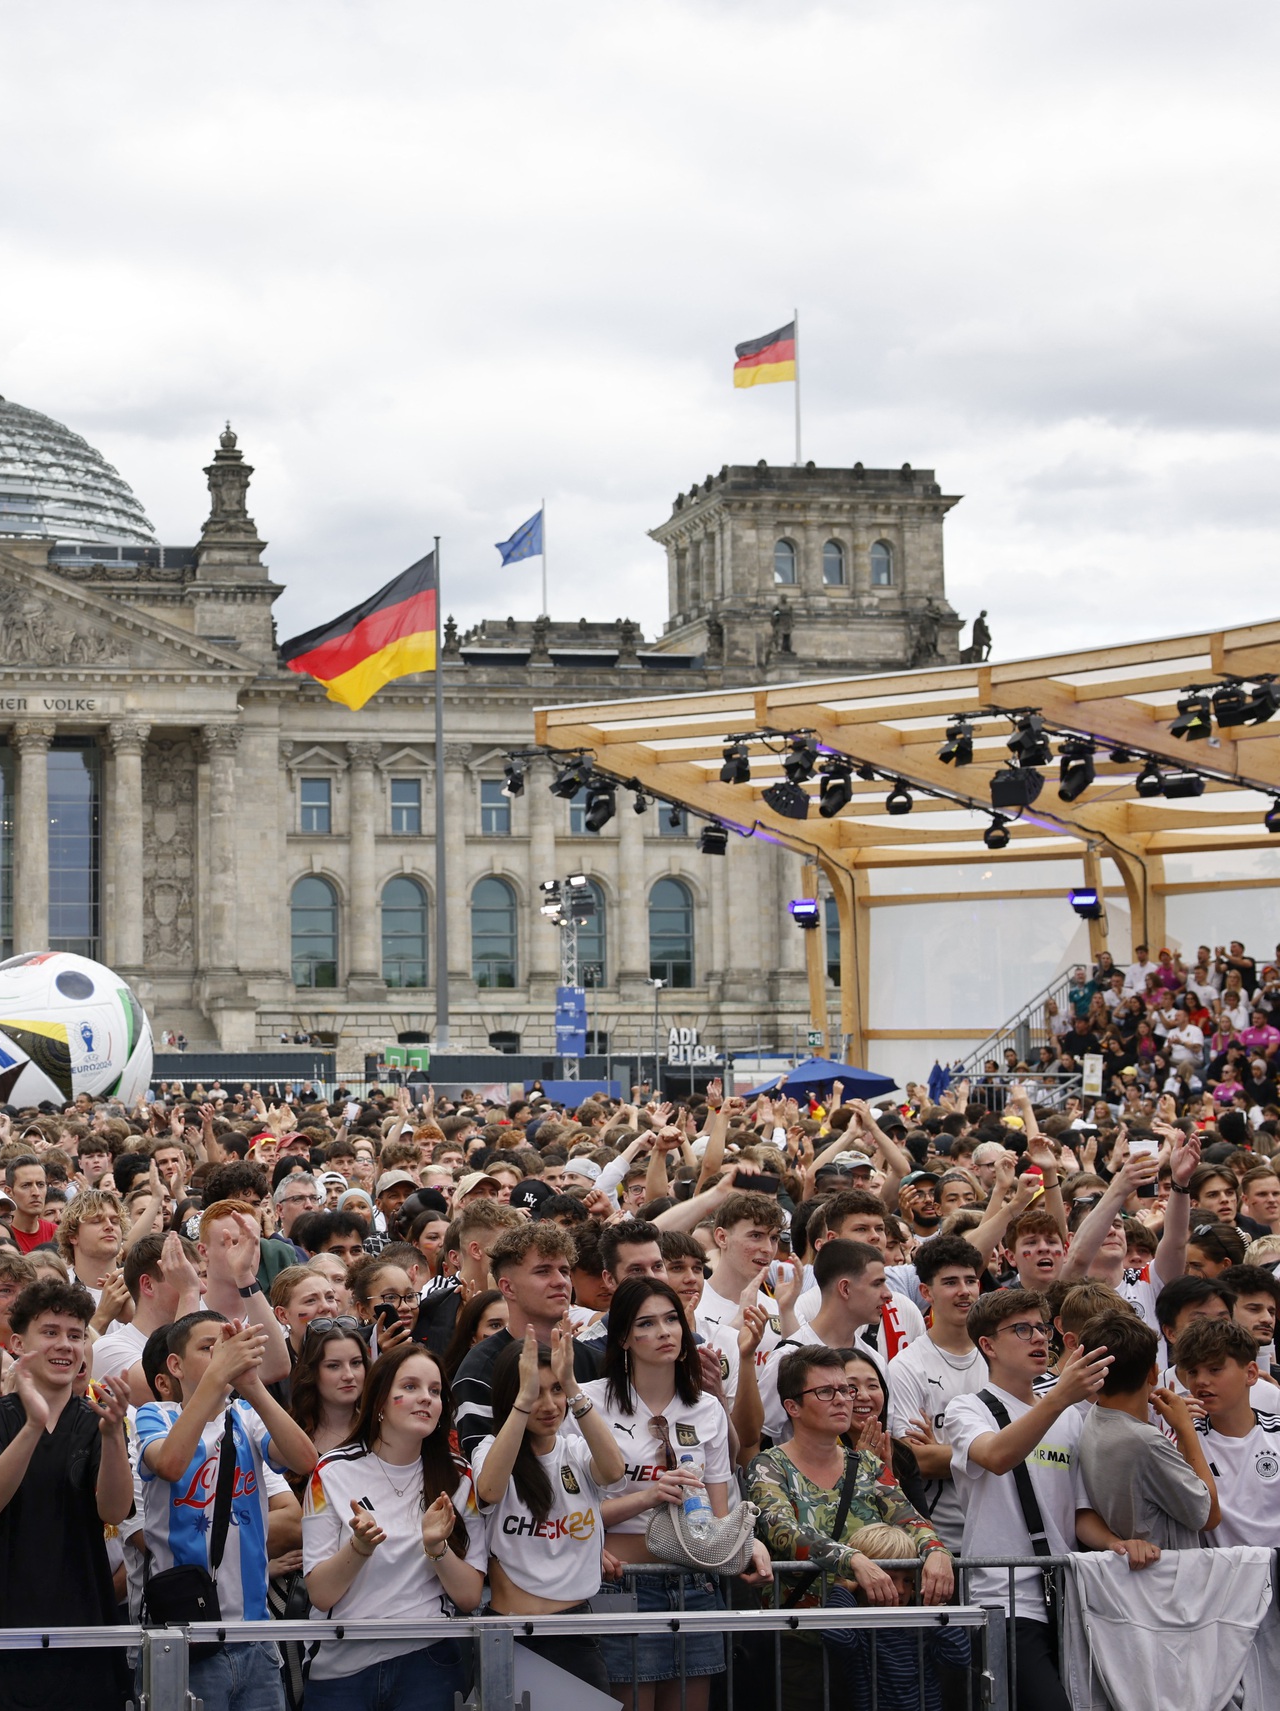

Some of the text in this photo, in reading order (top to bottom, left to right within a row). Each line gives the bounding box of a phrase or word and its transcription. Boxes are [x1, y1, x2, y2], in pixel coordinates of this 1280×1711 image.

[43, 698, 96, 711] VOLKE
[669, 1027, 697, 1045] ADI
[667, 1044, 716, 1065] PITCH
[523, 1192, 538, 1208] NY
[502, 1507, 596, 1540] CHECK24
